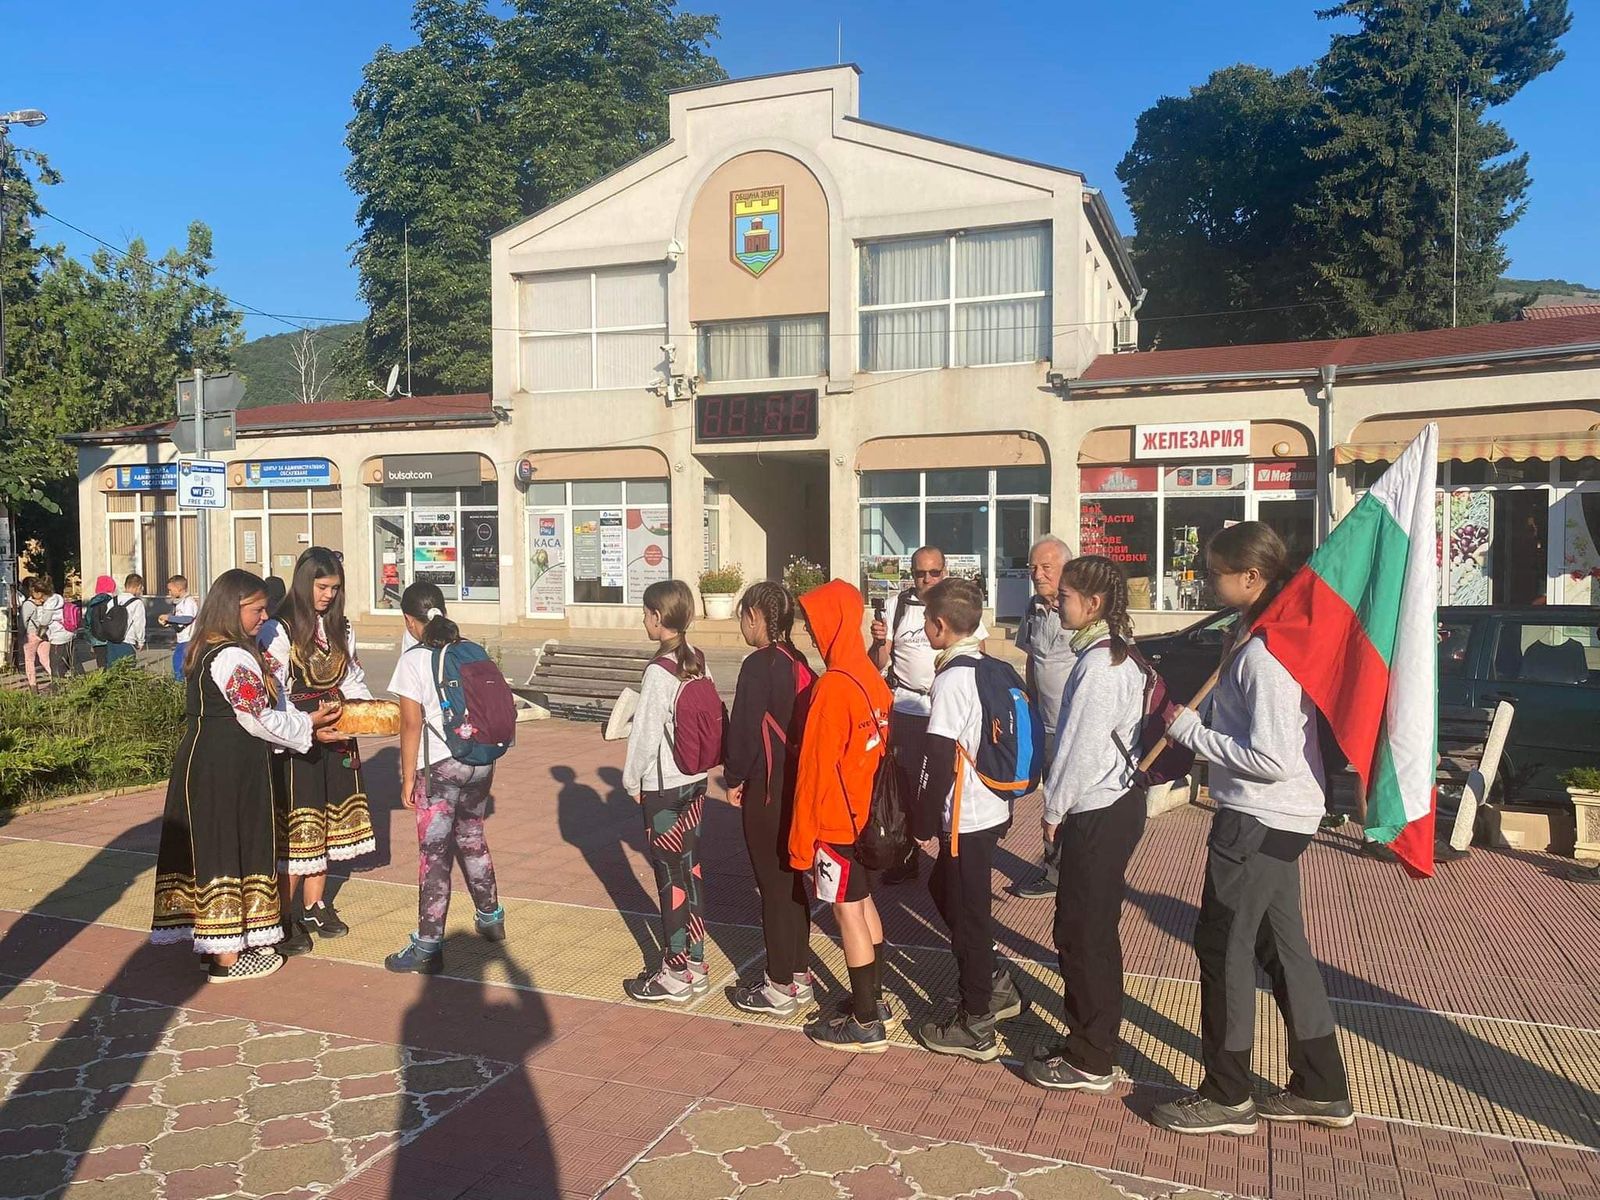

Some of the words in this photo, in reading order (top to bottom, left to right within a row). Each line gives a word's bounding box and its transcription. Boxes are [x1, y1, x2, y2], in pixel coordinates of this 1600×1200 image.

[735, 192, 760, 200] ОБЩИНА
[760, 190, 779, 198] ЗЕМЕН
[1142, 428, 1244, 450] ЖЕЛЕЗАРИЯ
[388, 470, 432, 480] bulsatcom
[534, 538, 560, 548] КАСА
